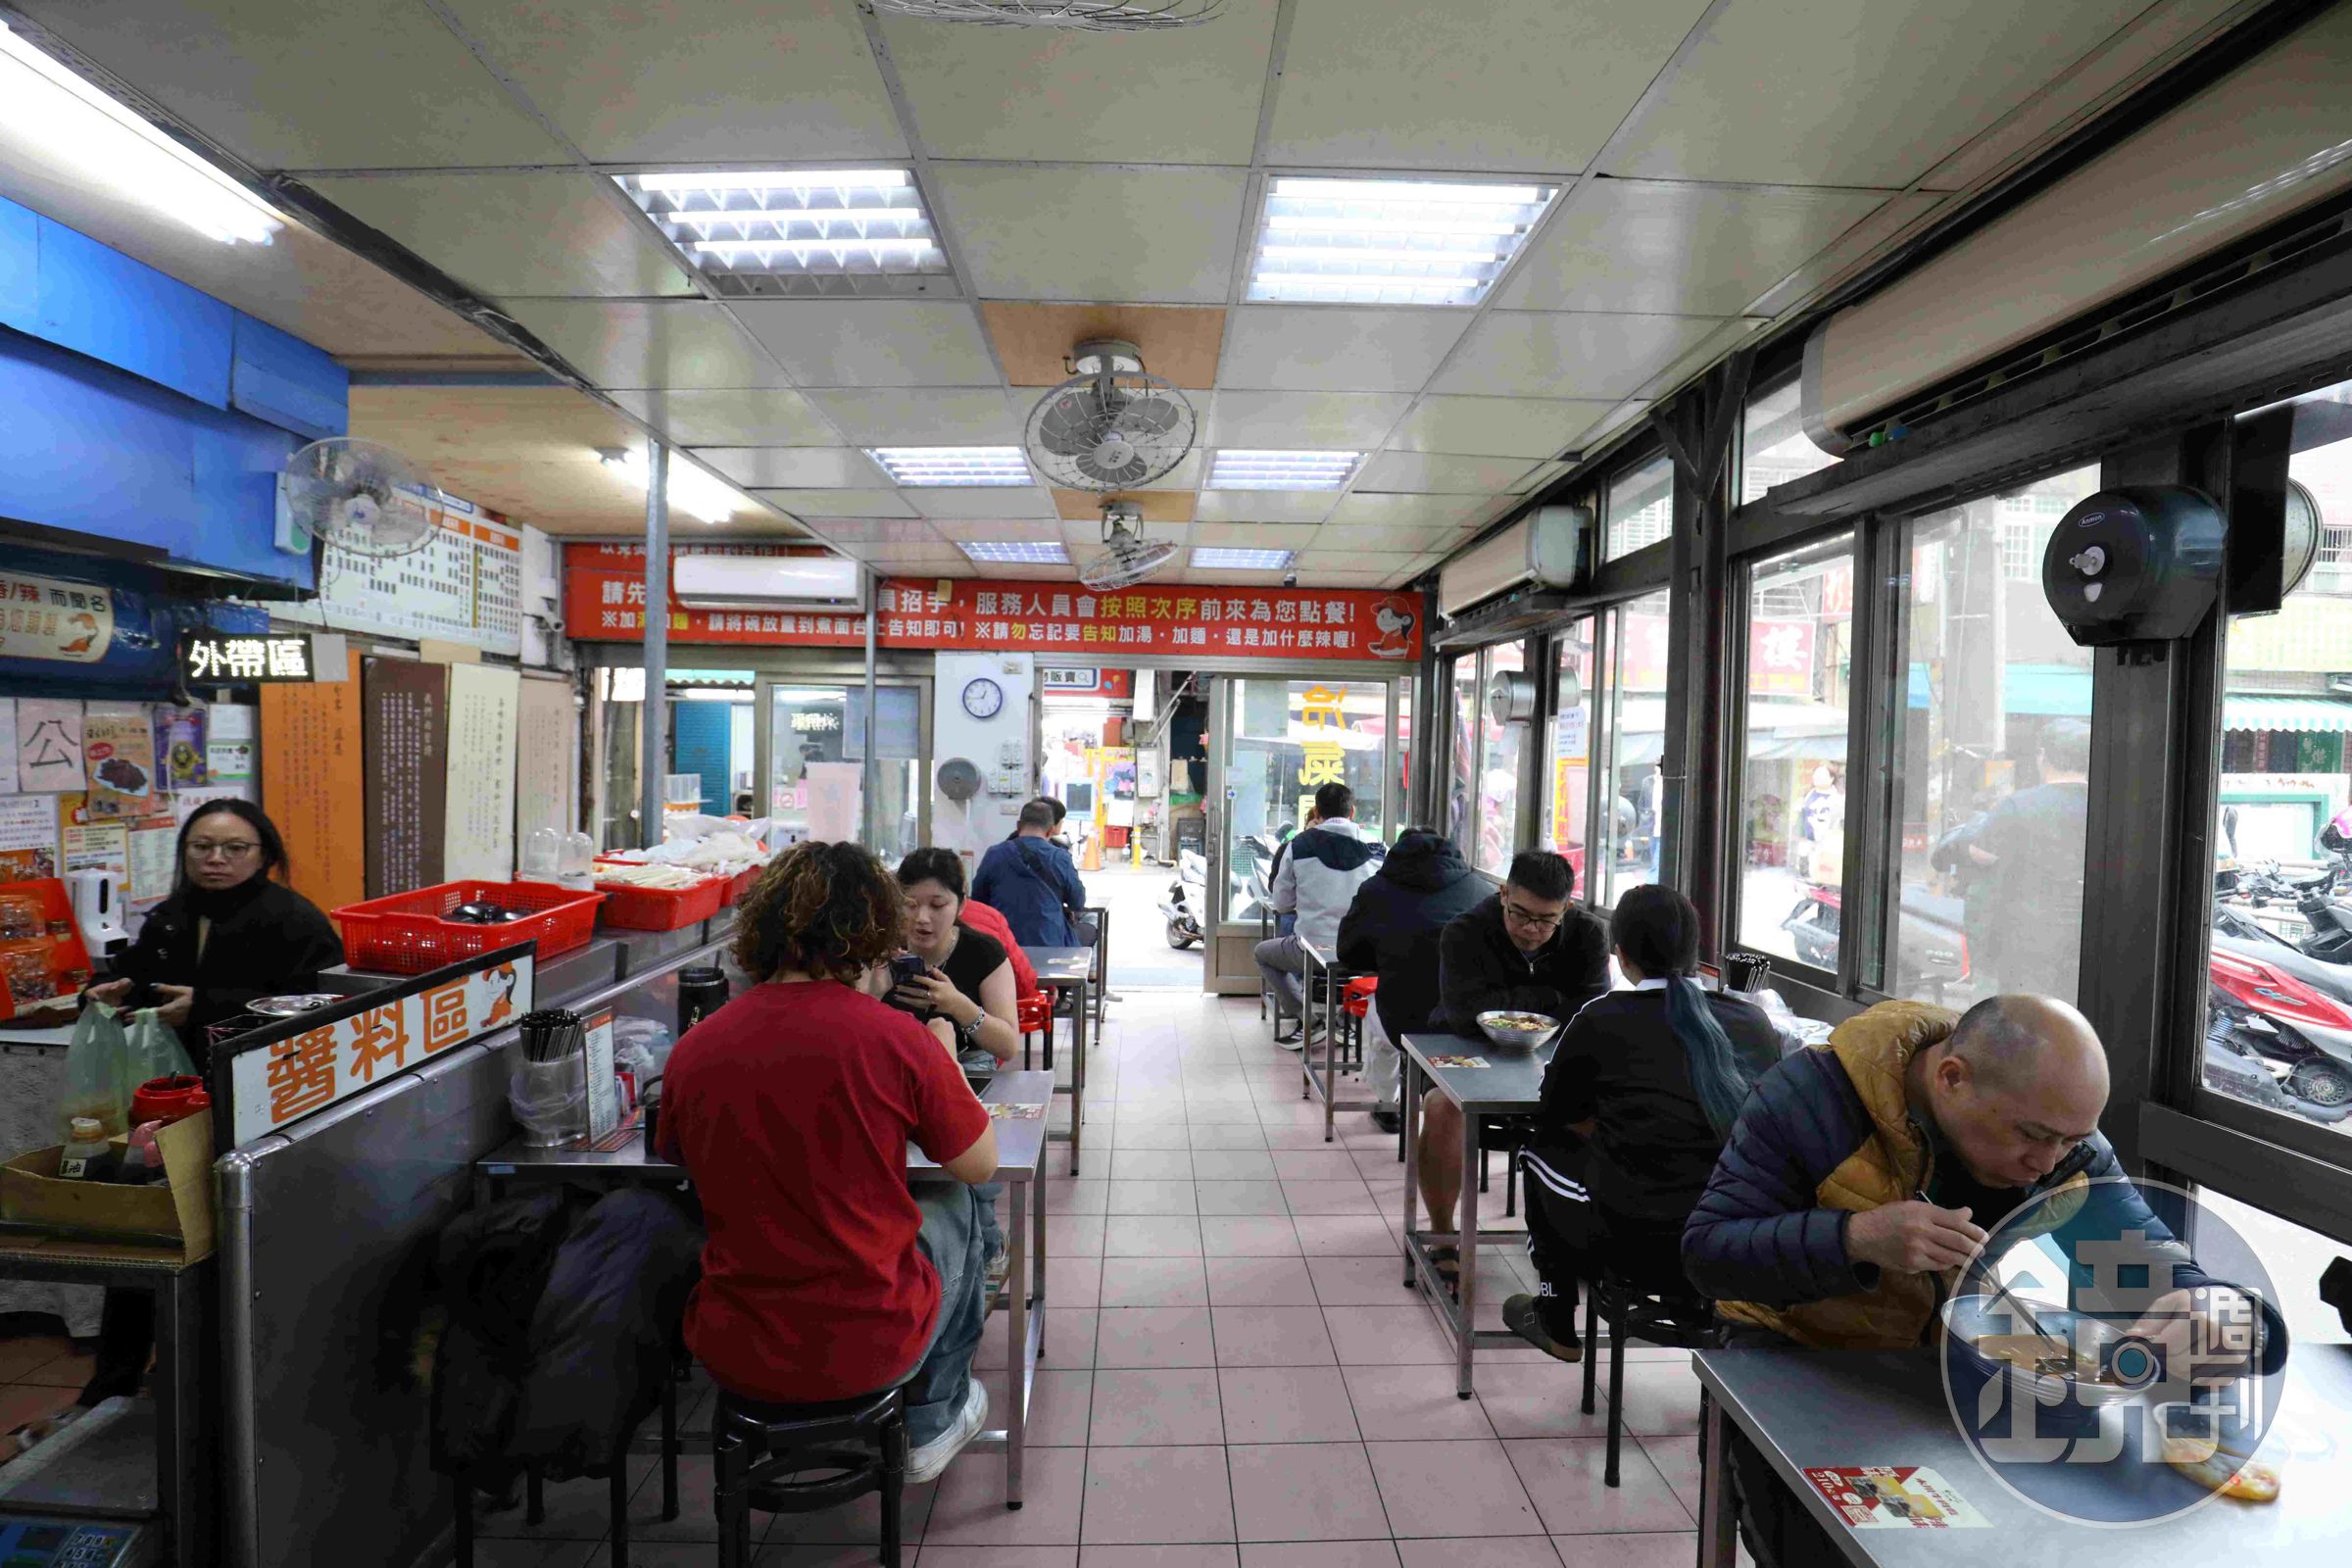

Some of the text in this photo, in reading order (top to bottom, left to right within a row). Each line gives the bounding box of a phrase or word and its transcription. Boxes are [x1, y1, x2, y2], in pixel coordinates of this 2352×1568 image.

[48, 588, 106, 612] 而聞名
[189, 638, 308, 678] 外帶區
[24, 719, 78, 769] 公
[267, 974, 470, 1124] 醬料區
